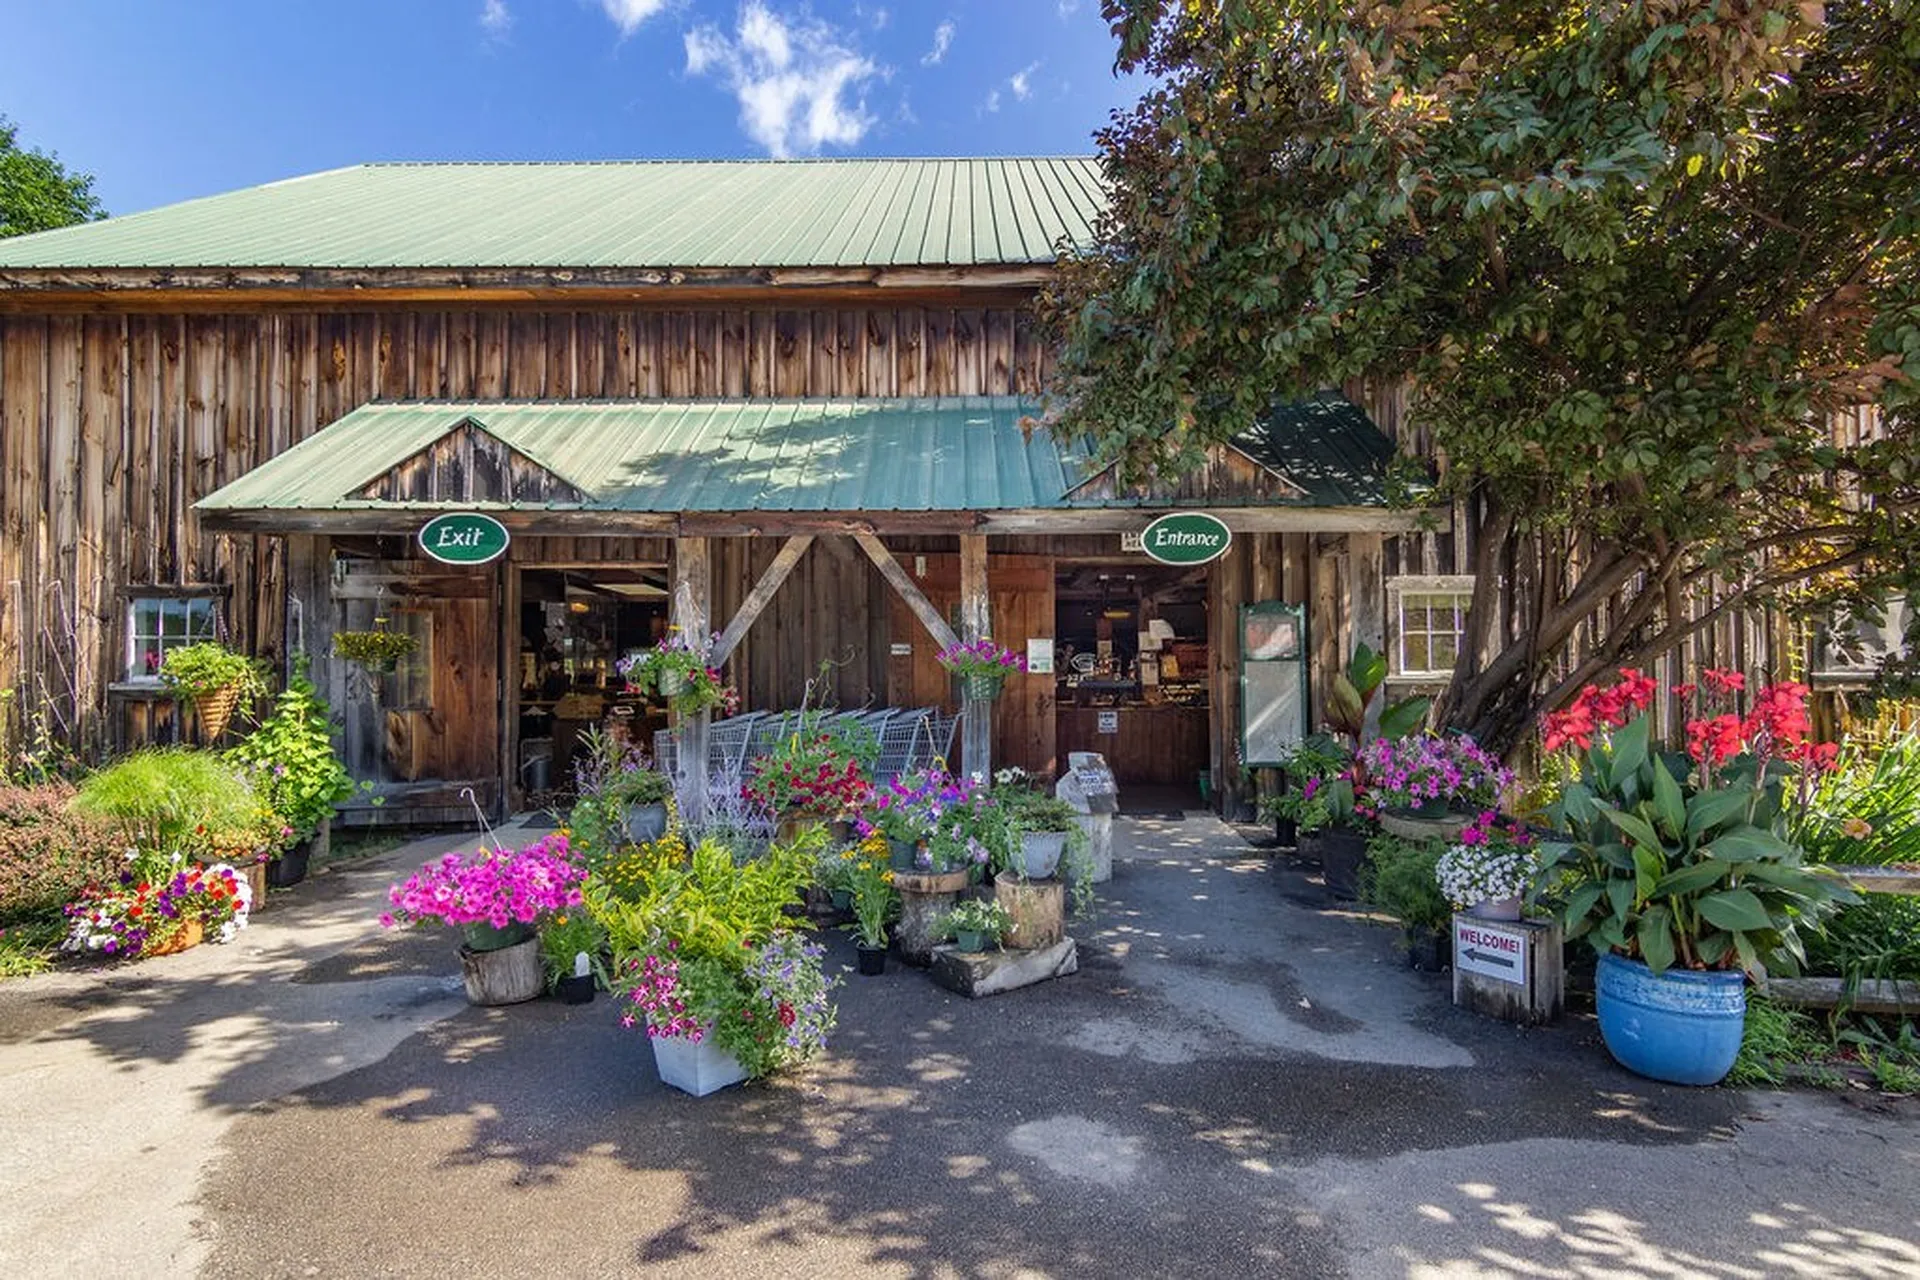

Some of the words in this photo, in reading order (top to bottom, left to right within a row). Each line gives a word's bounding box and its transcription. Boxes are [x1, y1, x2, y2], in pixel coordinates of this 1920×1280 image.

[436, 525, 485, 547] Exit
[1154, 527, 1220, 547] Entrance
[1459, 928, 1520, 954] WELCOME!
